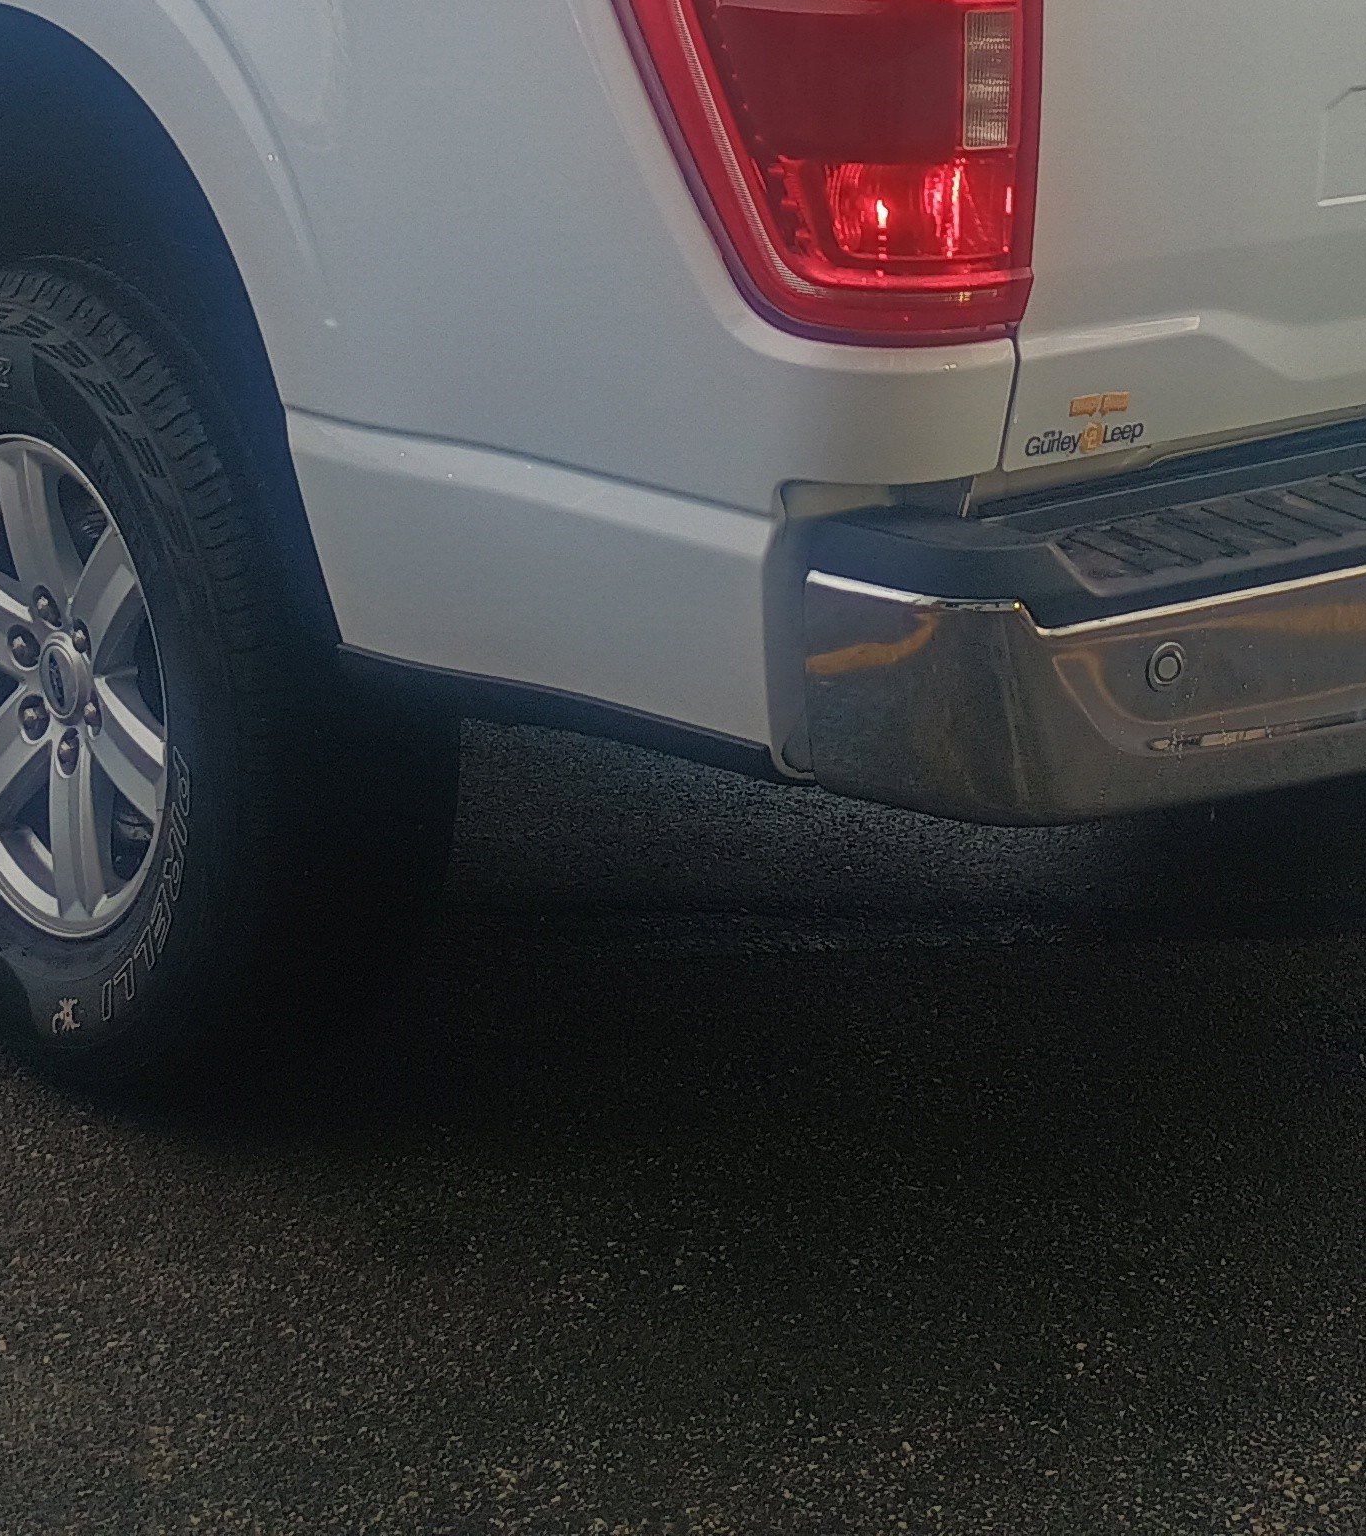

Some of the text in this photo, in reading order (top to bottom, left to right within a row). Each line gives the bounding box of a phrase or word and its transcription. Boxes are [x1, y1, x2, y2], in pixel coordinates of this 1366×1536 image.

[1025, 430, 1082, 456] Gurley
[1102, 422, 1144, 443] Leep
[101, 746, 190, 1021] PIRELLI
